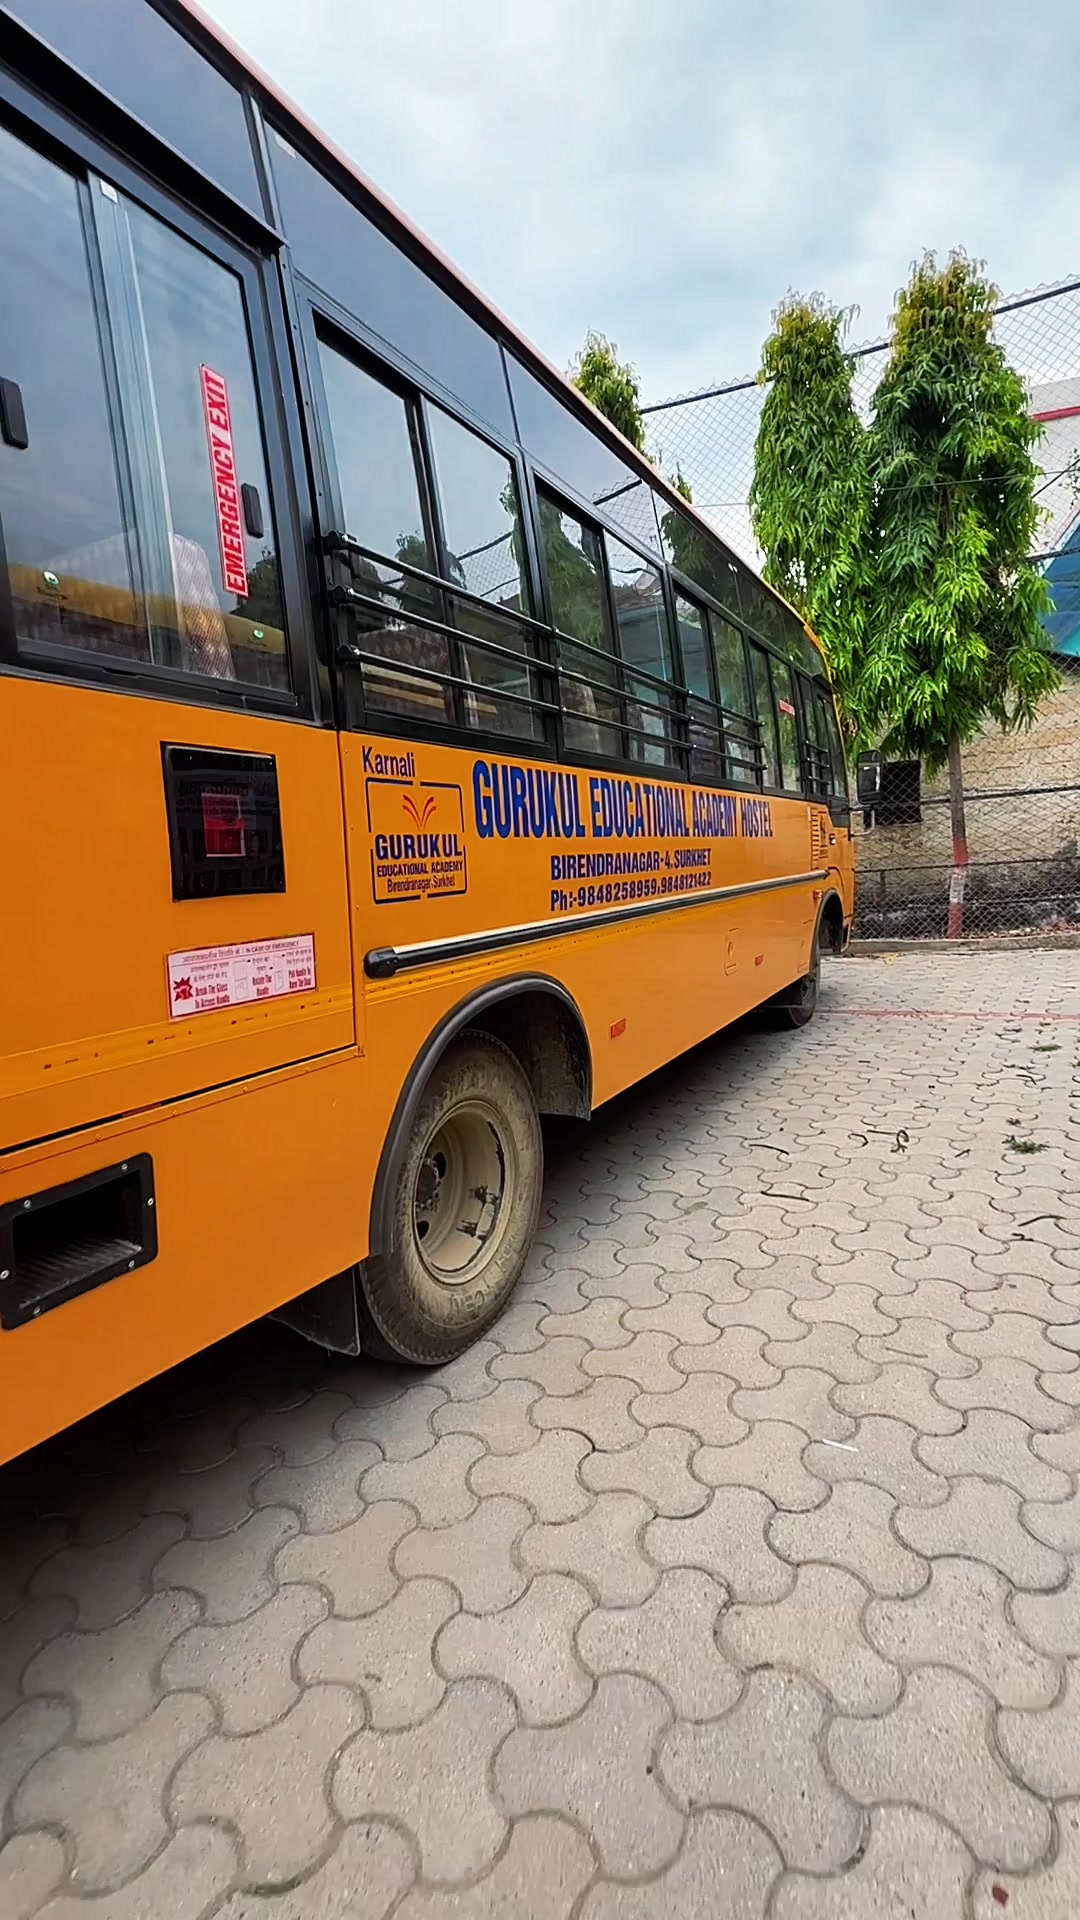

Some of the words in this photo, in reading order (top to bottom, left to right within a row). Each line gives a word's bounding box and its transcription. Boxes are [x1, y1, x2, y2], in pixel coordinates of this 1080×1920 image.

[204, 370, 229, 432] EXIT
[212, 437, 247, 594] EMERGENCY
[362, 745, 416, 777] Karnali
[472, 760, 585, 839] GURUKUL
[589, 777, 690, 838] EDUCATIONAL
[692, 790, 738, 838] ACADEMY
[740, 797, 774, 838] HOSTEL
[375, 833, 463, 860] GURUKUL
[376, 862, 429, 878] EDUCATIONAL
[431, 859, 463, 874] ACADEMY
